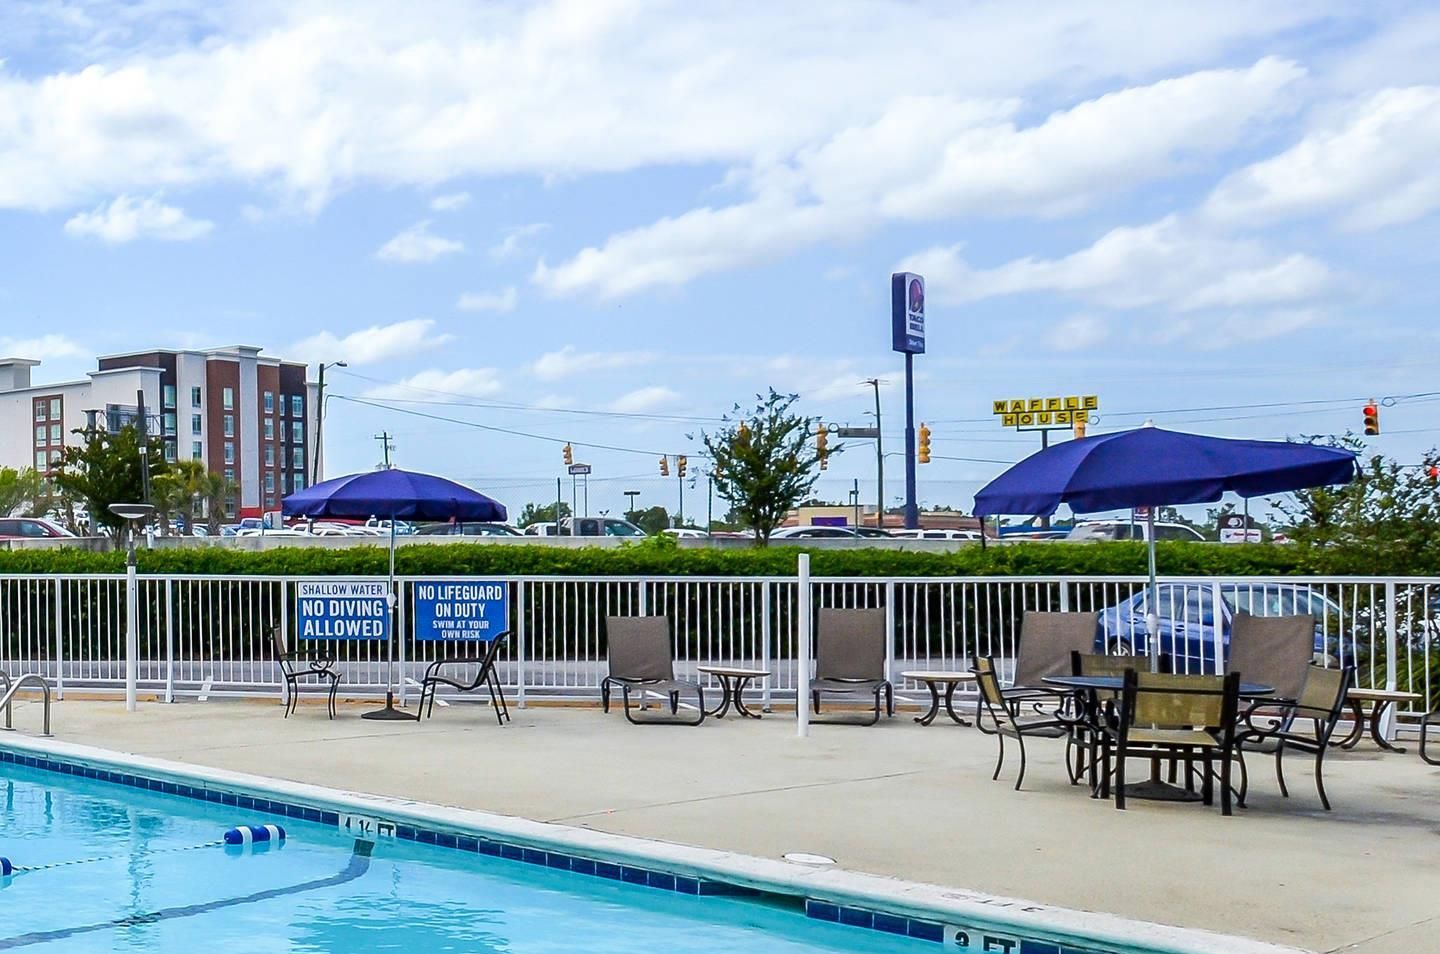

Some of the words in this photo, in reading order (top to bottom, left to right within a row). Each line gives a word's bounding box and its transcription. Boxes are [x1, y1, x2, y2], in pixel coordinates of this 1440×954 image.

[994, 397, 1094, 411] WAFFLE
[1004, 411, 1085, 425] HOUSE
[302, 584, 347, 595] SHALLOW
[350, 584, 383, 595] WATER
[418, 585, 435, 600] NO
[437, 585, 503, 600] LIFEGUARD
[303, 600, 325, 617] NO
[329, 600, 384, 617] DIVING
[435, 603, 452, 618] ON
[455, 603, 486, 618] DUTY
[303, 619, 383, 636] ALLOWED
[432, 620, 455, 629] SWIM
[456, 620, 467, 629] AT
[469, 620, 490, 629] YOUR
[441, 630, 461, 639] OWN
[462, 630, 481, 639] RISK
